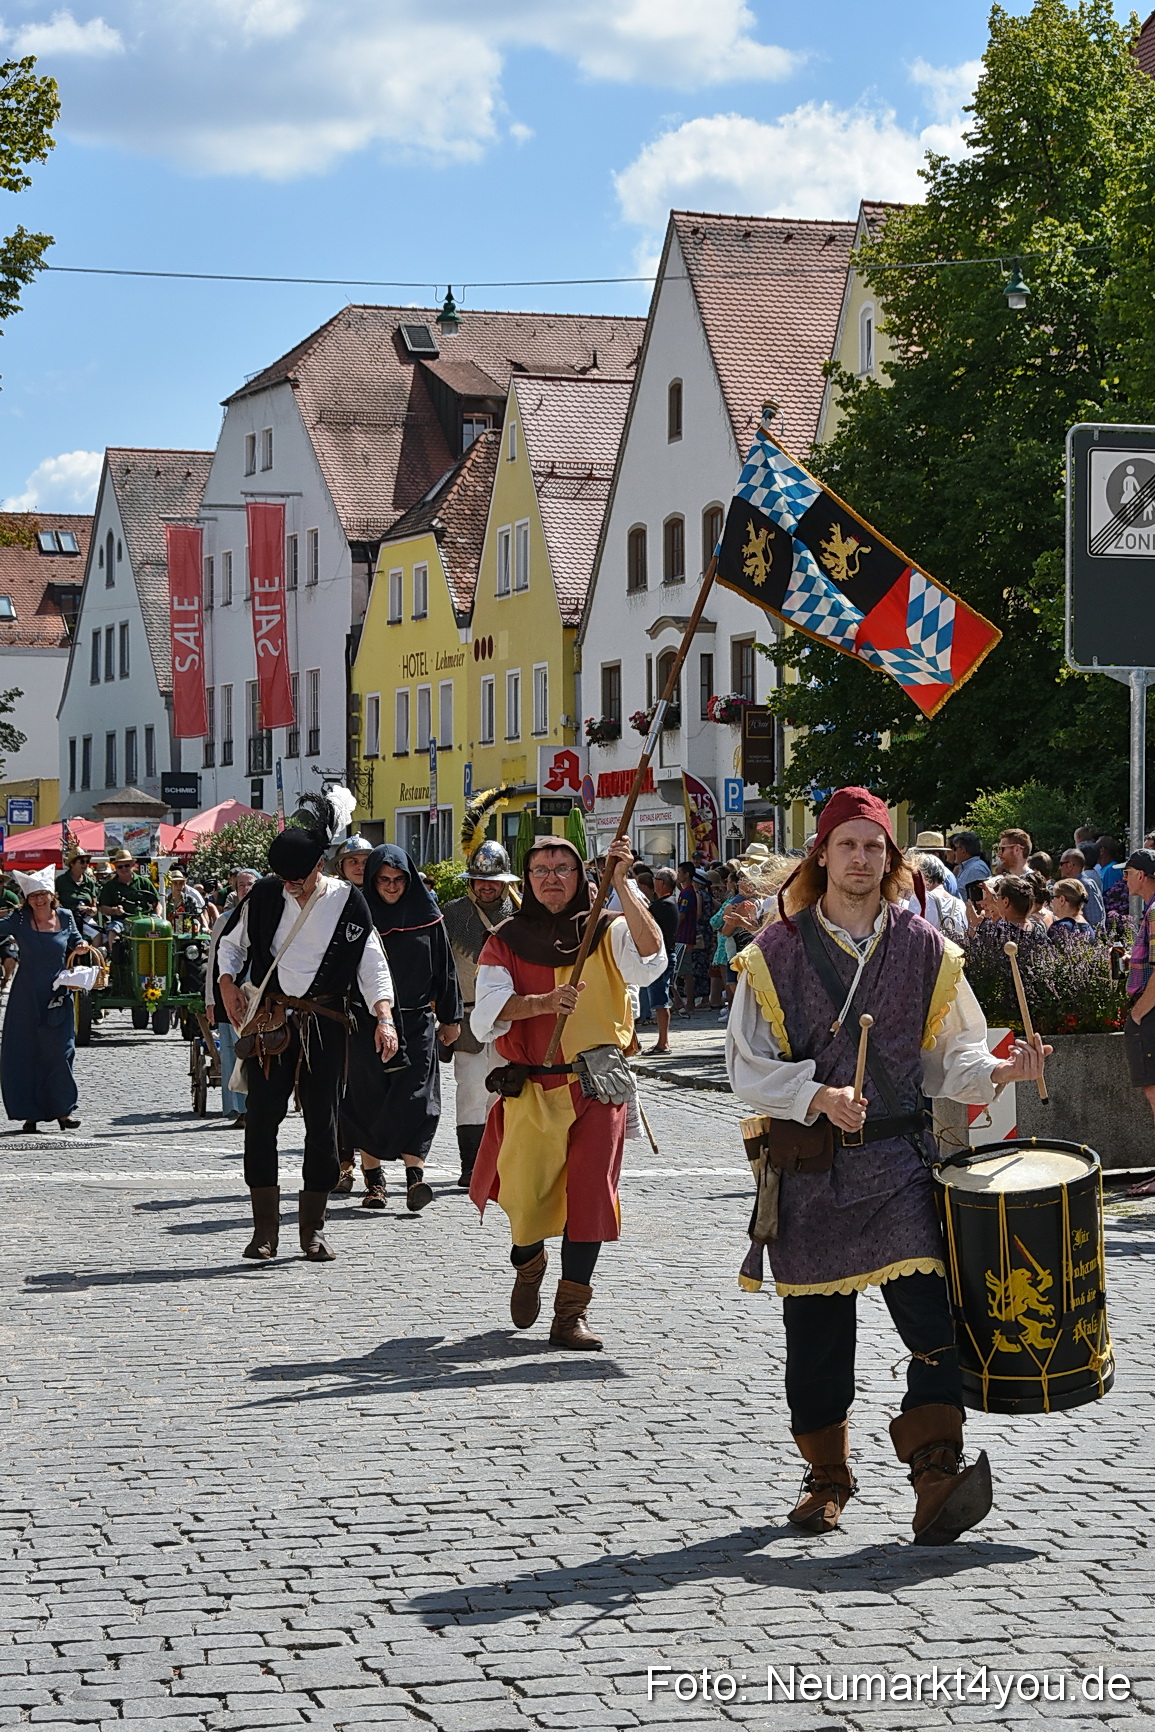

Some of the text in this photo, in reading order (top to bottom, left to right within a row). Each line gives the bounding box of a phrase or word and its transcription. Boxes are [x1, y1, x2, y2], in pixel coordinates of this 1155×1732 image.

[173, 596, 199, 672] SALE
[402, 648, 465, 679] HOTEL Lehmeier
[400, 782, 430, 801] Restaura
[596, 767, 656, 798] APOTHE
[688, 794, 711, 808] EIS
[728, 783, 740, 808] P
[1071, 1228, 1090, 1251] Für
[1087, 1288, 1097, 1303] die
